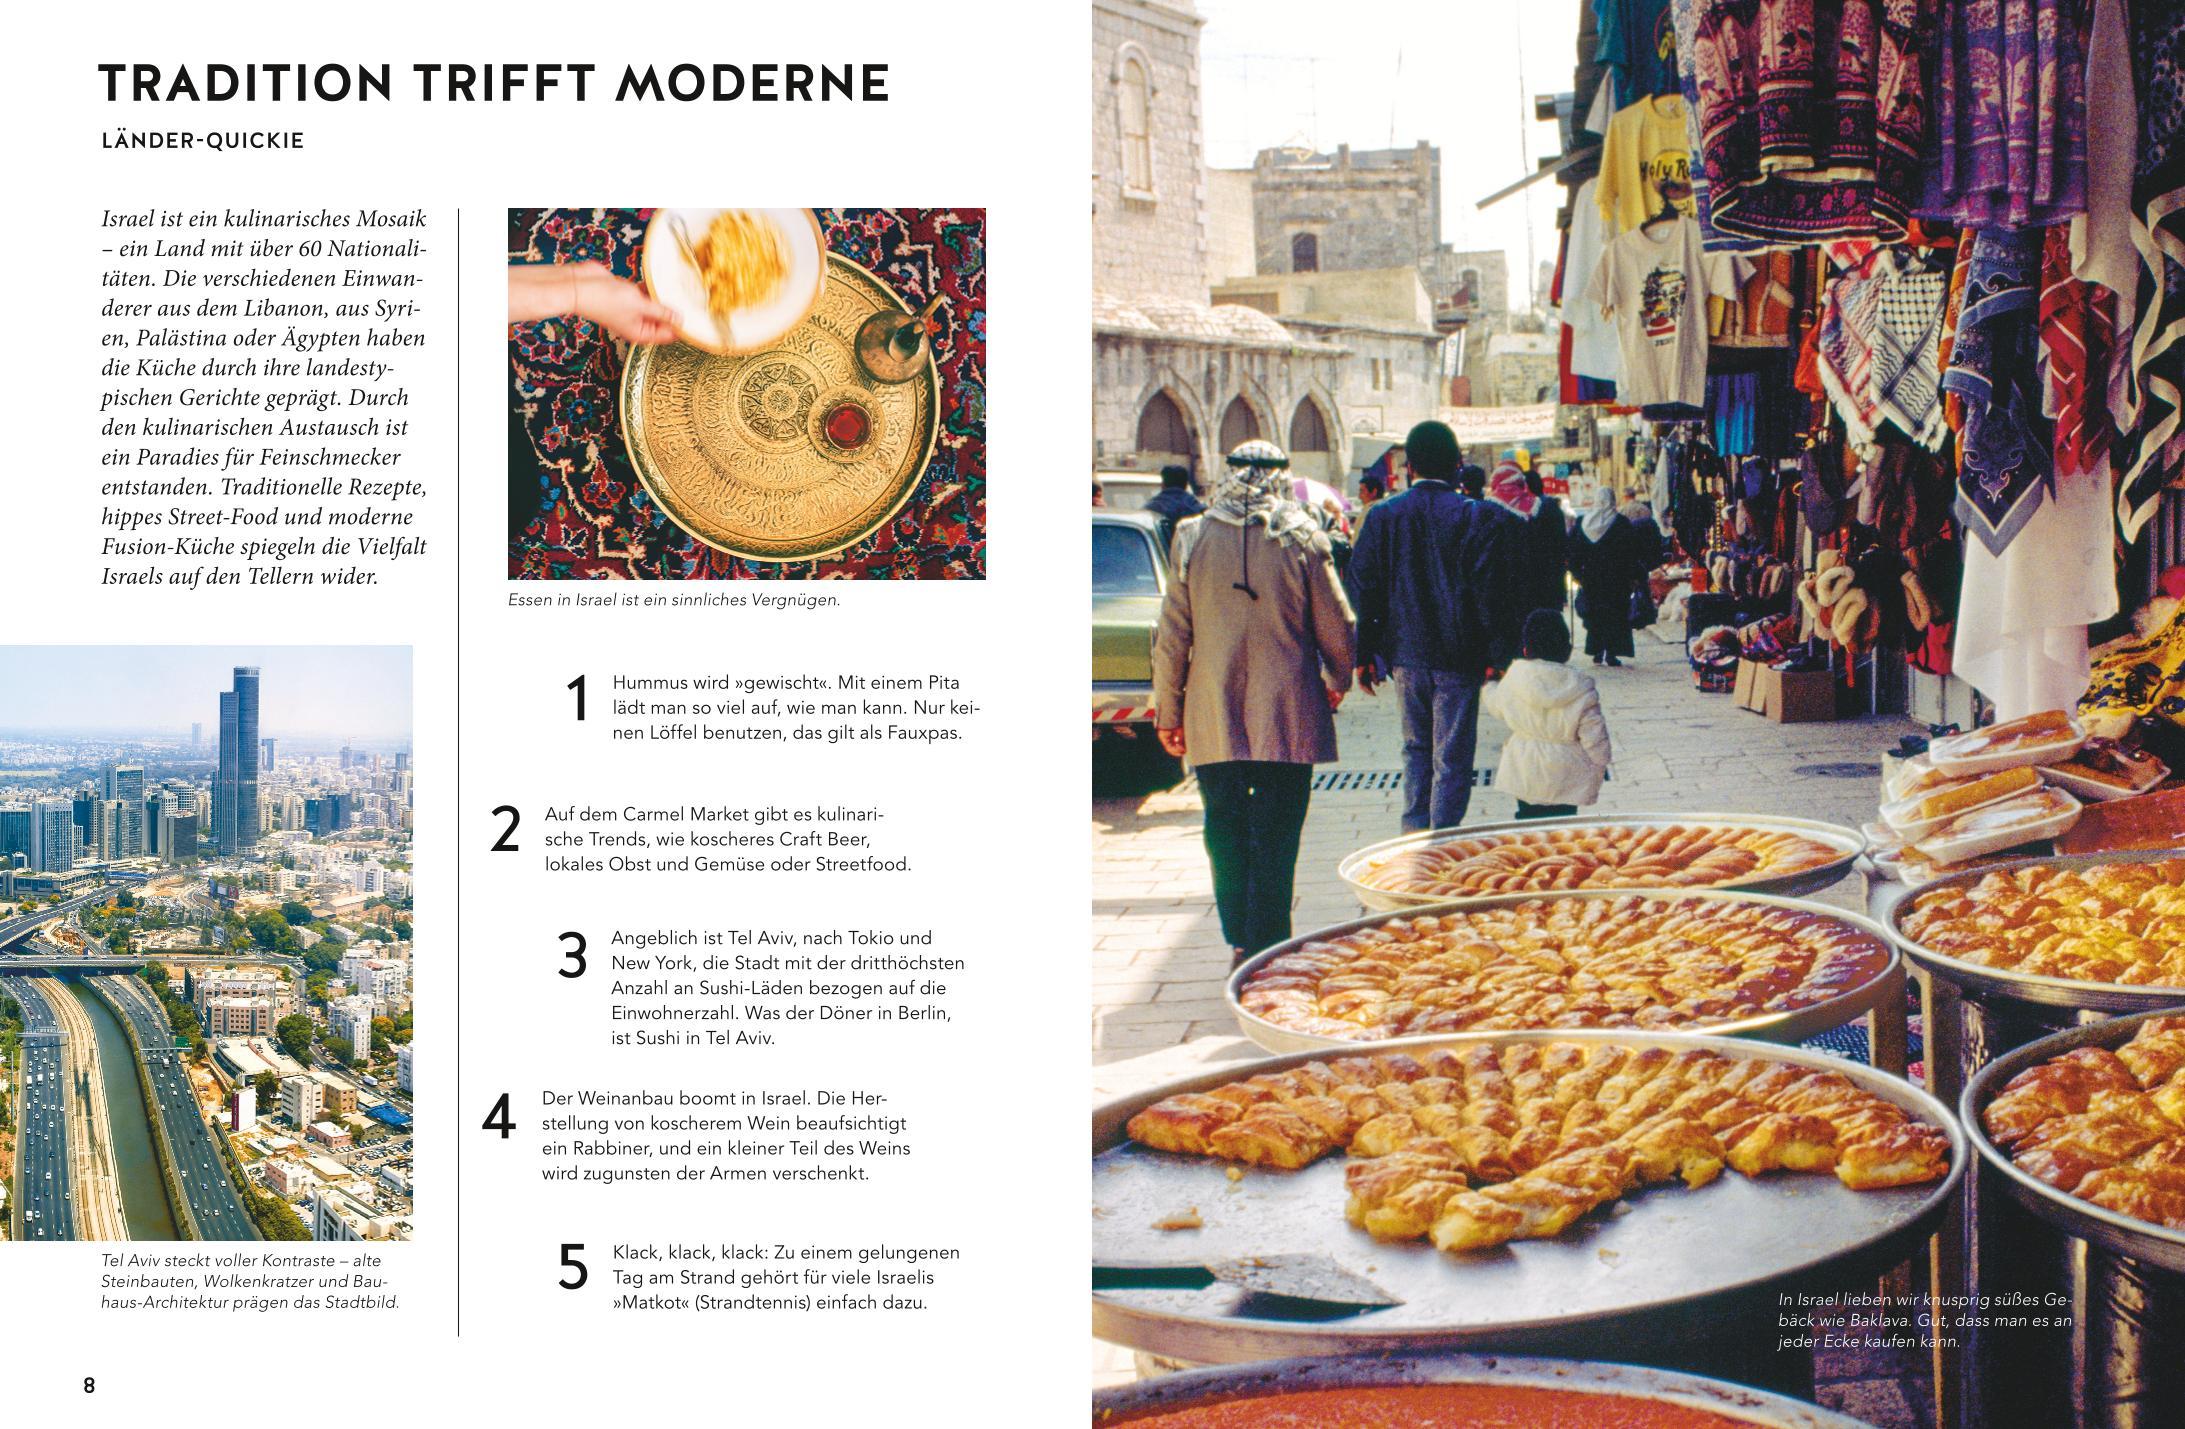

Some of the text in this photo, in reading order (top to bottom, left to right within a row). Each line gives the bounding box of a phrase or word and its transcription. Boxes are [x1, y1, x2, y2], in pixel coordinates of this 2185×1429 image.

[97, 63, 889, 102] TRADITION TRIFFT MODERNE
[102, 127, 304, 152] LÄNDER-QUICKIE
[101, 208, 427, 228] Israel ist ein kulinarisches Mosaik
[101, 325, 425, 353] en, Palästina oder Ägypten haben
[99, 387, 409, 412] pischen Gerichte geprägt. Durch
[101, 446, 403, 473] ein Paradies für Feinschmecker
[101, 506, 413, 531] hippes Street-Food und moderne
[101, 566, 378, 591] Israels auf den Tellern wider.
[508, 592, 841, 610] Essen in Israel ist ein sinnliches Vergnügen.
[613, 673, 960, 694] Hummus wird »gewischt«. Mit einem Pita
[567, 674, 585, 721] 1
[613, 723, 962, 745] nen Löffel benutzen, das gilt als Fauxpas.
[490, 804, 521, 852] 2
[545, 830, 870, 849] sche Trends, wie koscheres Craft Beer,
[545, 855, 912, 872] lokales Obst und Gemüse oder Streetfood.
[610, 929, 932, 950] Angeblich ist Tel Aviv, nach Tokio und
[557, 931, 587, 979] 3
[610, 979, 947, 1000] Anzahl an Sushi-Läden bezogen auf die
[612, 1029, 775, 1045] ist Sushi in Tel Aviv.
[542, 1089, 888, 1106] Der Weinanbau boomt in Israel. Die Her-
[481, 1092, 517, 1140] 4
[542, 1114, 907, 1135] stellung von koscherem Wein beaufsichtigt
[541, 1164, 869, 1185] wird zugunsten der Armen verschenkt.
[101, 1252, 124, 1267] Tel
[127, 1253, 161, 1267] Aviv
[164, 1252, 211, 1267] steckt
[215, 1252, 259, 1267] voller
[262, 1253, 335, 1267] Kontraste
[353, 1252, 382, 1267] alte
[613, 1243, 960, 1264] Klack, klack, klack: Zu einem gelungenen
[558, 1243, 588, 1290] 5
[101, 1273, 388, 1290] Steinbauten, Wolkenkratzer und Bau-
[101, 1294, 399, 1313] haus-Architektur prägen das Stadtbild.
[613, 1293, 927, 1312] »Matkot« (Strandtennis) einfach dazu.
[83, 1376, 96, 1394] 8
